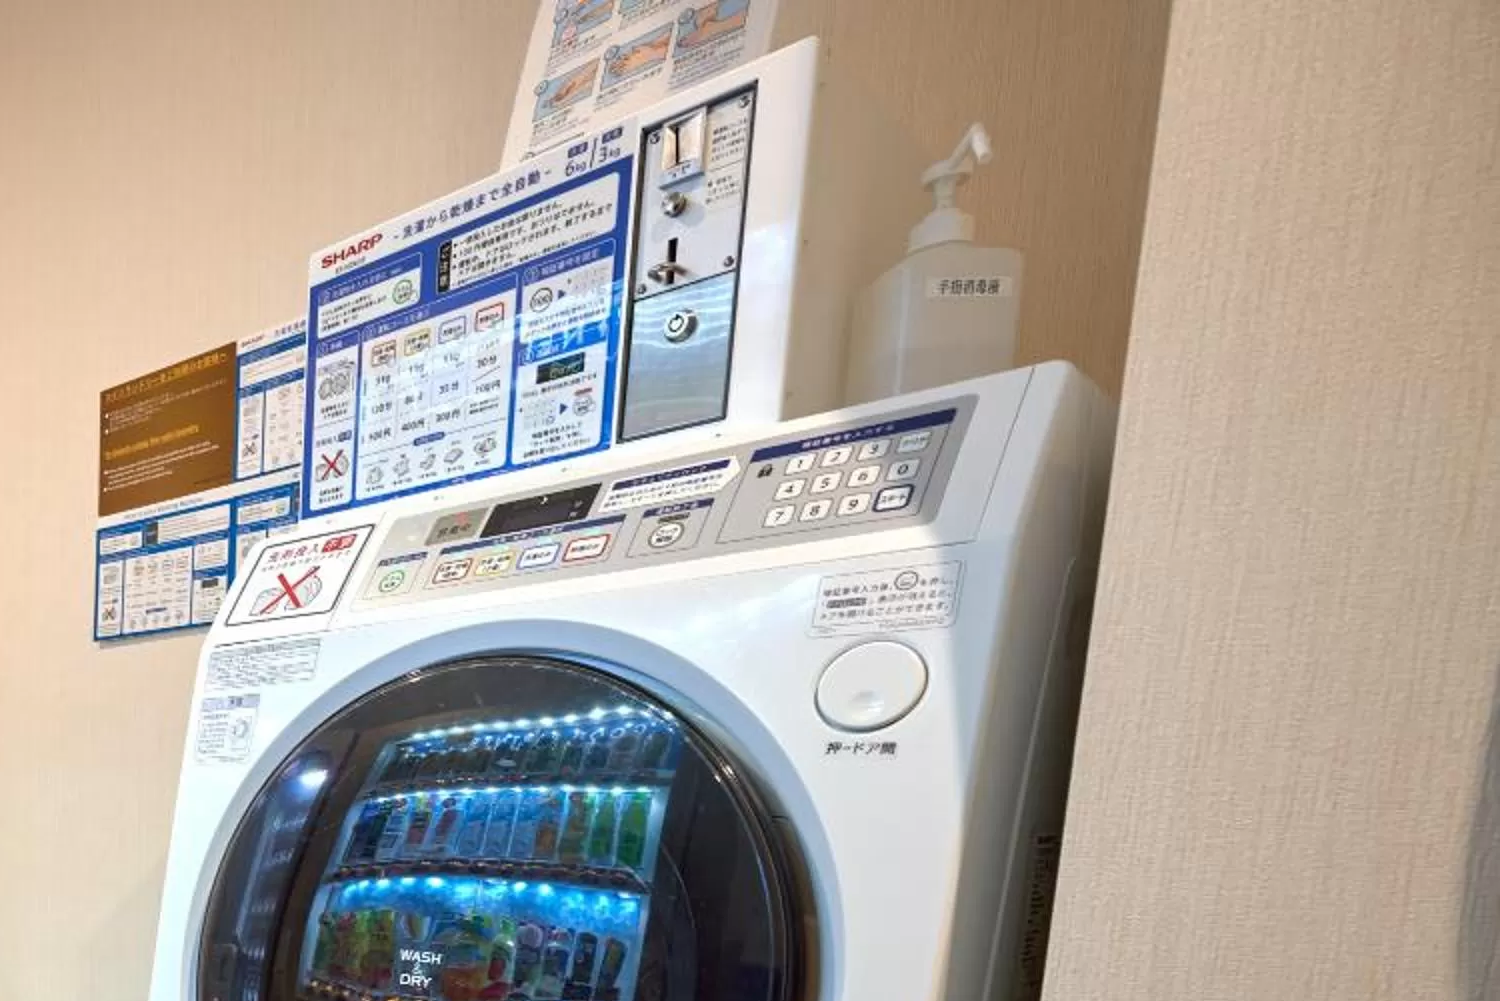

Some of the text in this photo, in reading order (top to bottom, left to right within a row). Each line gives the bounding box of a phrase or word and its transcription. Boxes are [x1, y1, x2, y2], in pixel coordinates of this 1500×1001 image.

[321, 232, 383, 269] SHARP
[936, 279, 1001, 296] 手指消毒液
[399, 948, 443, 965] WASH
[399, 972, 432, 988] DRY
